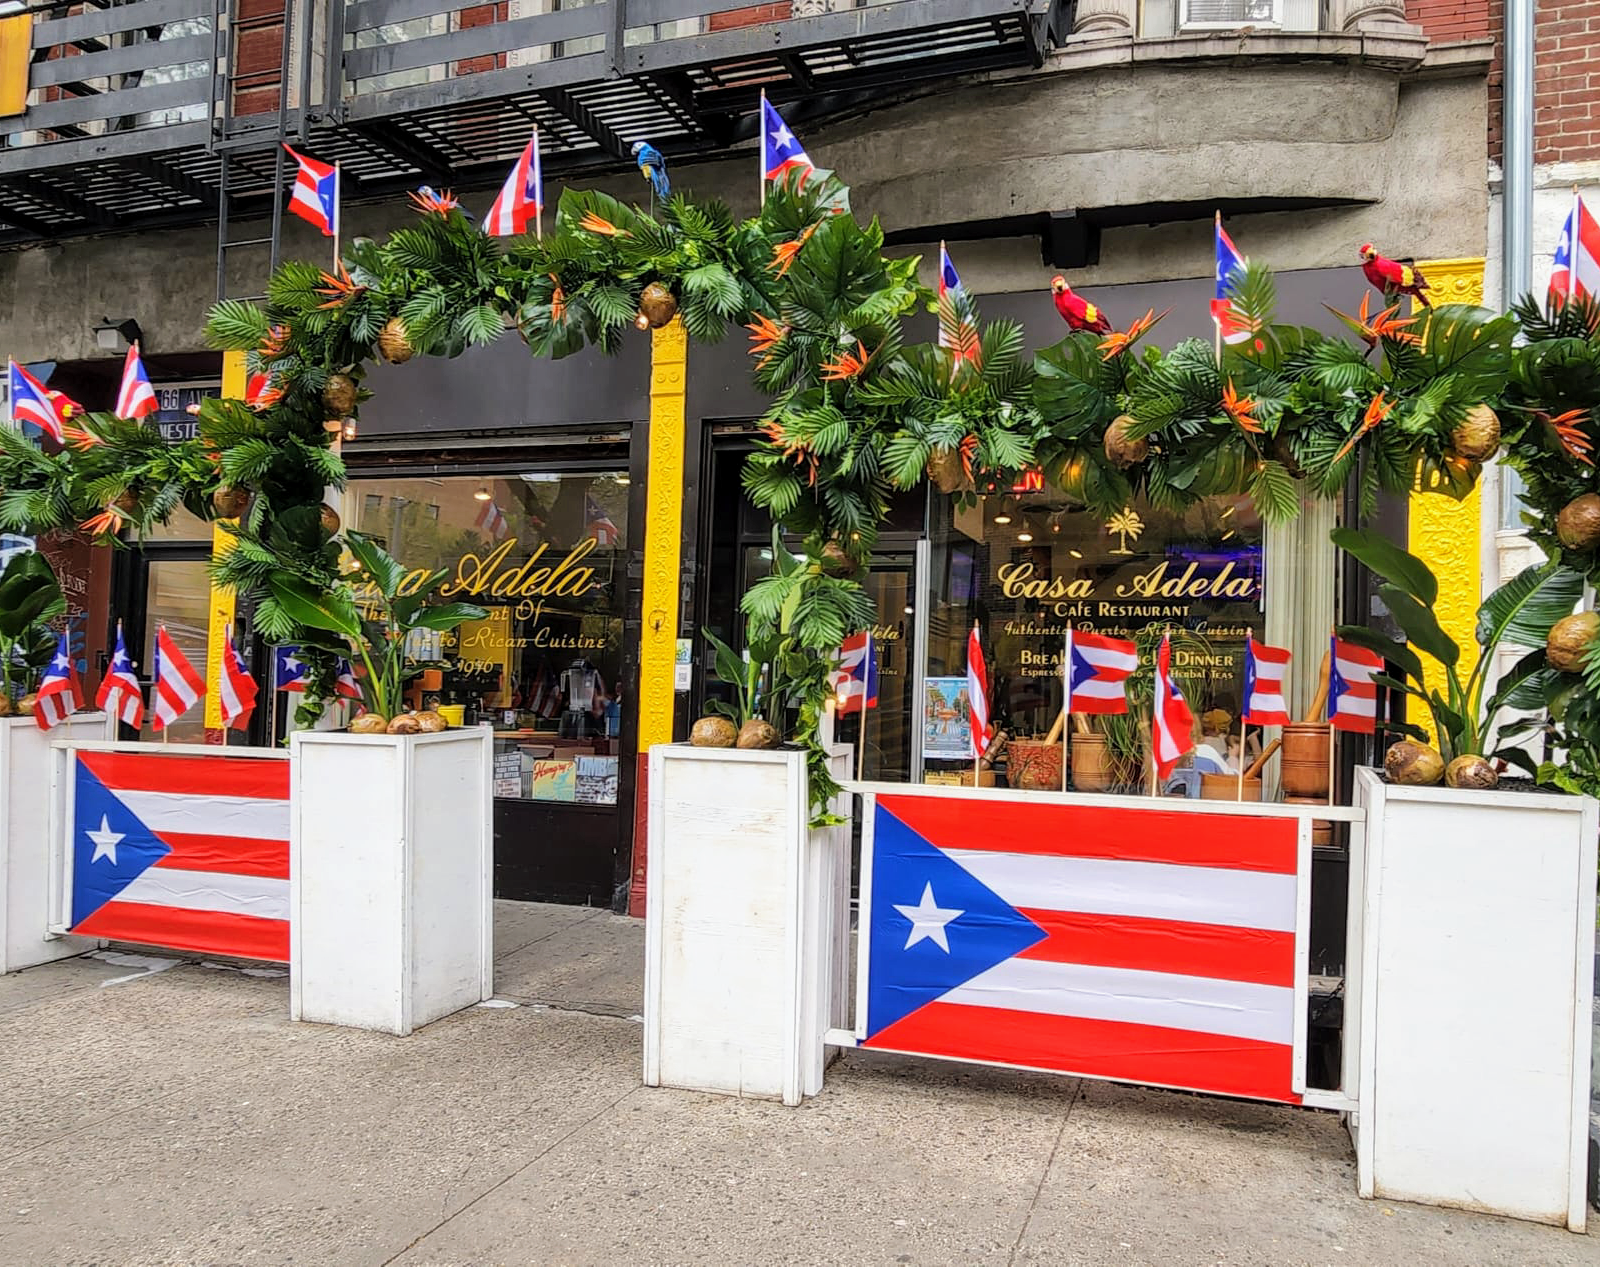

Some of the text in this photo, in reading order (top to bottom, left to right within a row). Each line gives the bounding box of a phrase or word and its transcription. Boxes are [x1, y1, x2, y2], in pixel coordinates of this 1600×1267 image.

[161, 388, 179, 410] 66
[440, 537, 597, 597] Adela
[998, 561, 1255, 598] Casa Adela
[515, 599, 545, 628] Of
[1099, 602, 1189, 617] RESTAURANT
[463, 627, 527, 649] Rican
[534, 627, 606, 649] Cuisine
[1195, 621, 1252, 636] Cuisin
